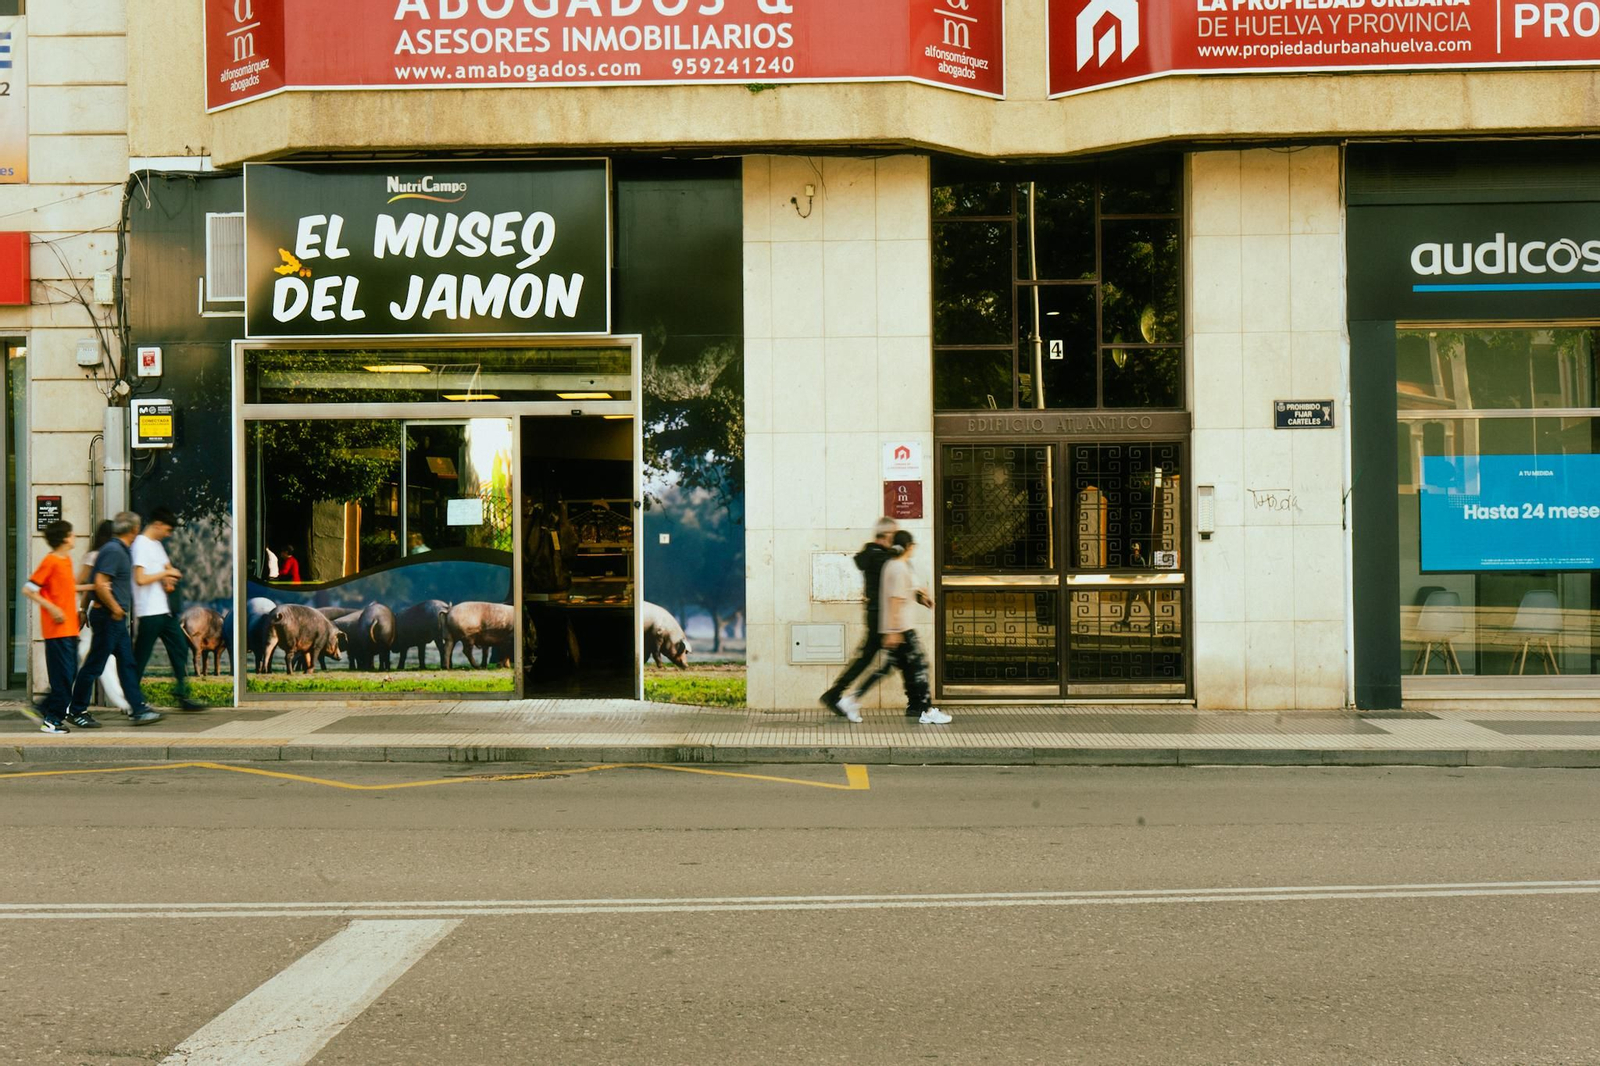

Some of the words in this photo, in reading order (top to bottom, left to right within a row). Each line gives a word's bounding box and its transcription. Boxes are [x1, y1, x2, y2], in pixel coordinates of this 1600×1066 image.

[1198, 17, 1228, 37] DE
[1235, 14, 1324, 36] HUELVA
[1328, 14, 1342, 34] Y
[1348, 11, 1472, 34] PROVINCIA
[1515, 2, 1600, 38] PRO
[394, 27, 550, 54] ASESORES
[562, 22, 794, 52] INMOBILIARIOS
[1197, 38, 1472, 59] www.propiedadurbanahuelva.com
[394, 54, 641, 81] www.amabogados.com
[671, 56, 795, 75] 959241240
[924, 44, 989, 70] alfonsomárquez
[220, 58, 270, 83] alfonsomárquez
[938, 61, 976, 80] abogados
[230, 74, 260, 93] abogados
[386, 175, 467, 193] NutriCampo
[295, 213, 350, 260] EL
[373, 210, 556, 262] MUSEO
[1410, 232, 1600, 275] audicos
[272, 275, 366, 323] DEL
[389, 255, 585, 321] JAMÓN
[1051, 341, 1062, 357] 4
[967, 418, 1045, 433] EDIFICIO
[1055, 415, 1153, 432] ATLANTICO
[1287, 418, 1321, 426] CARTELES
[1294, 410, 1313, 418] FIJAR
[1464, 504, 1519, 520] Hasta
[1522, 503, 1545, 519] 24
[1548, 506, 1600, 519] mese
